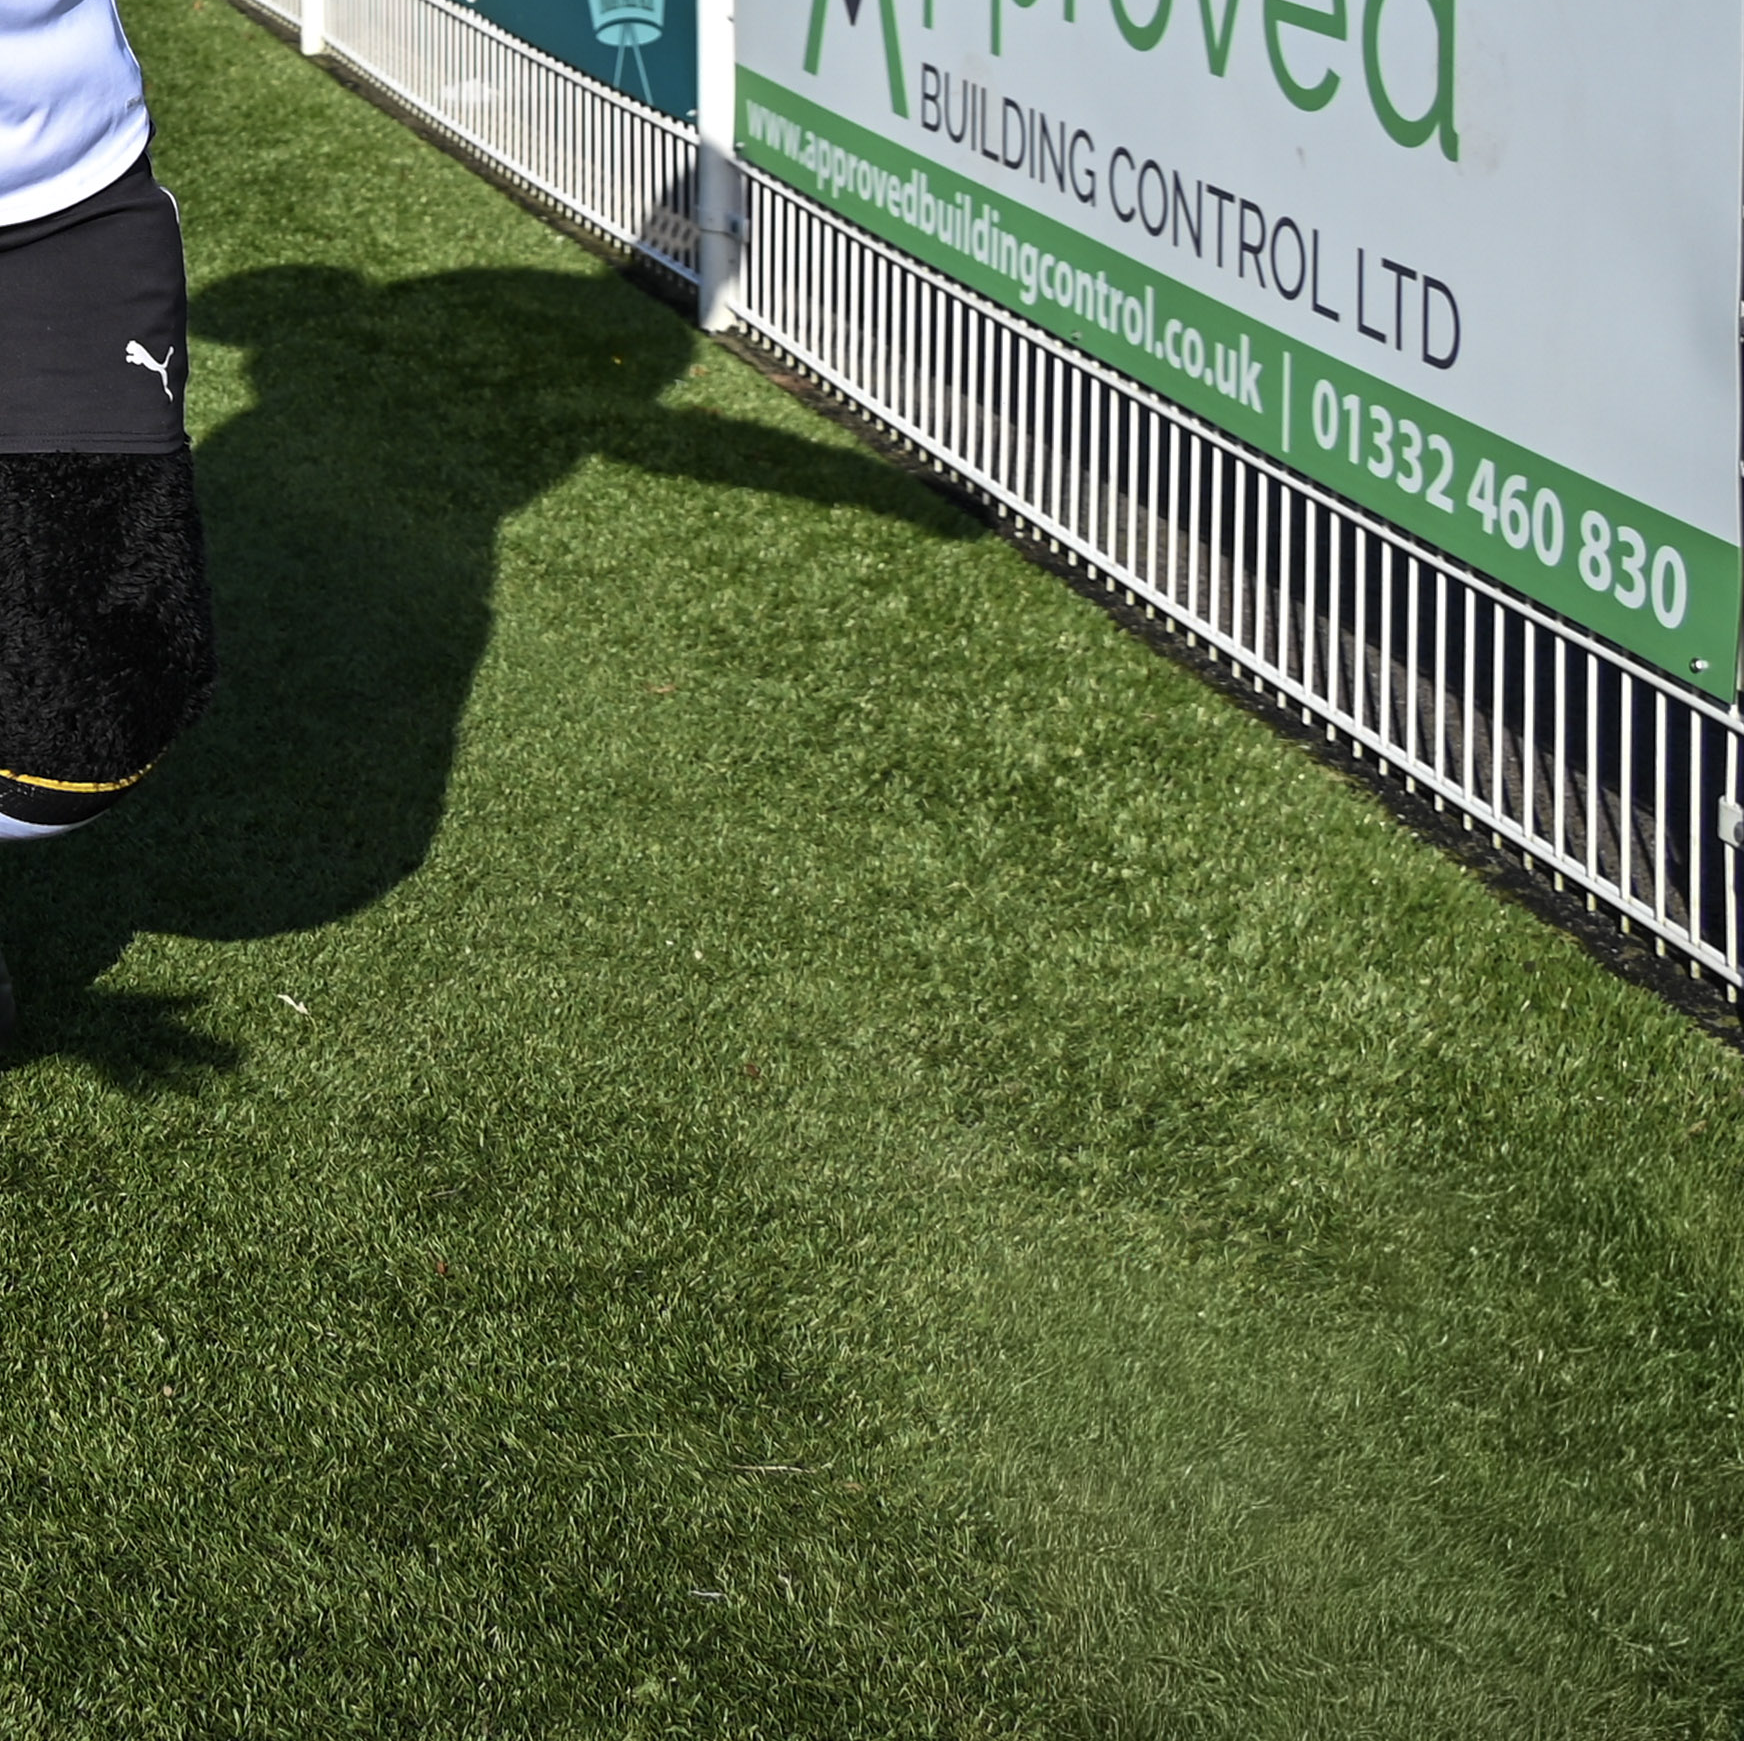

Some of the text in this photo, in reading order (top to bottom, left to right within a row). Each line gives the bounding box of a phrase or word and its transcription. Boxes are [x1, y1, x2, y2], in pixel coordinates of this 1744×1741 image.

[745, 98, 1263, 413] www.approvedbuildingcontrol.co.uk
[1312, 379, 1455, 515] 01332
[1467, 458, 1565, 568] 460
[1578, 509, 1688, 629] 830
[921, 62, 1461, 370] BUILDING CONTROL LTD
